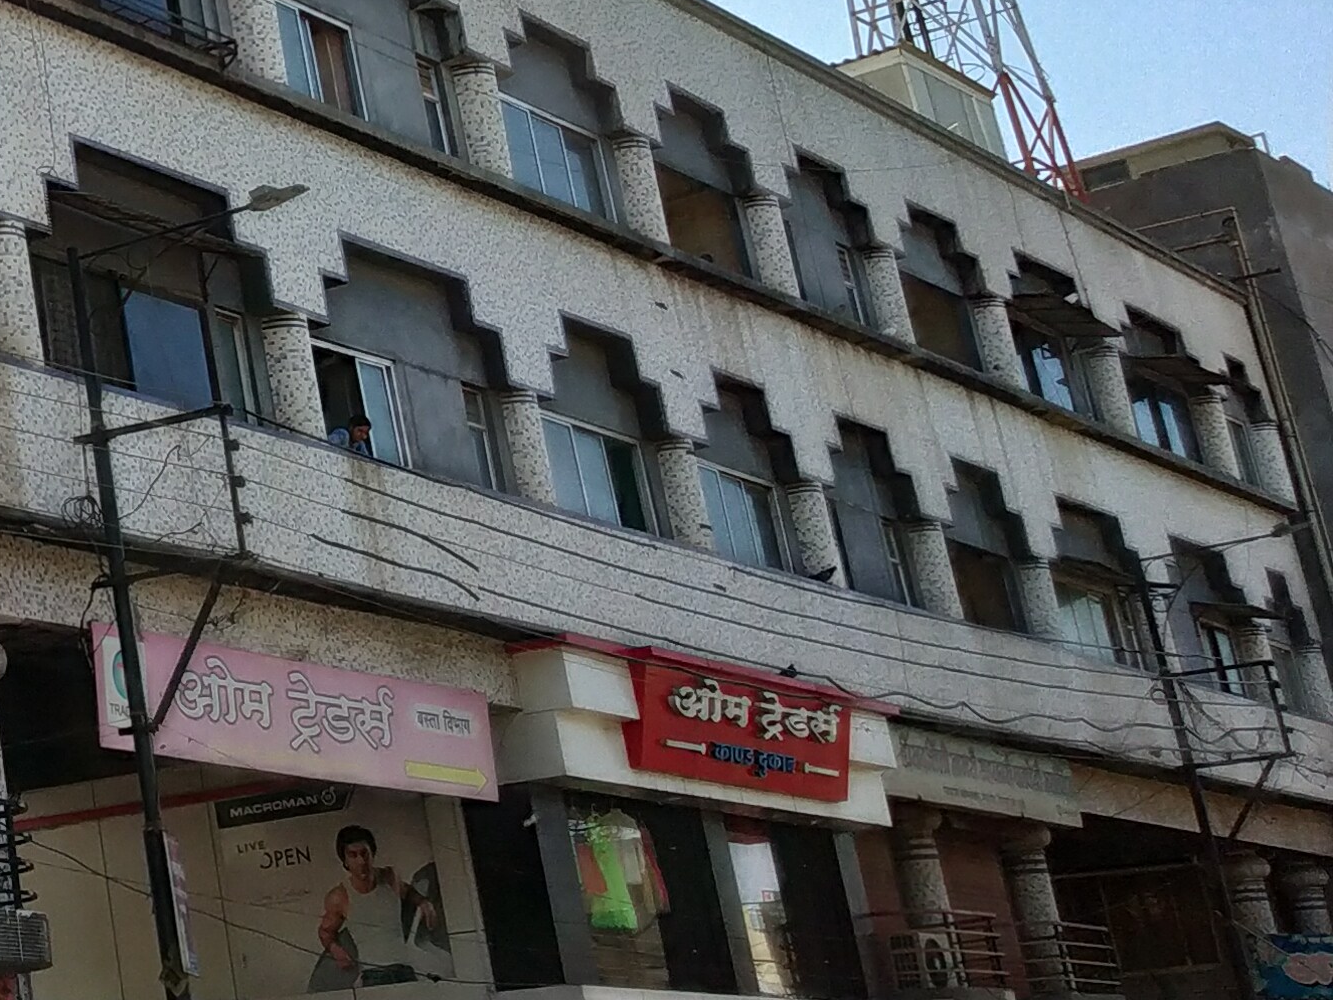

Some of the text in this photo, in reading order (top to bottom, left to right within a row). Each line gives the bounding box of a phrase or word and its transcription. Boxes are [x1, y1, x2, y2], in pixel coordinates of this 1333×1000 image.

[176, 656, 395, 754] ओम ट्रेडर्स
[669, 678, 843, 744] ओम ट्रेडर्स
[229, 795, 318, 818] MACROMAN
[236, 840, 265, 854] LIVE
